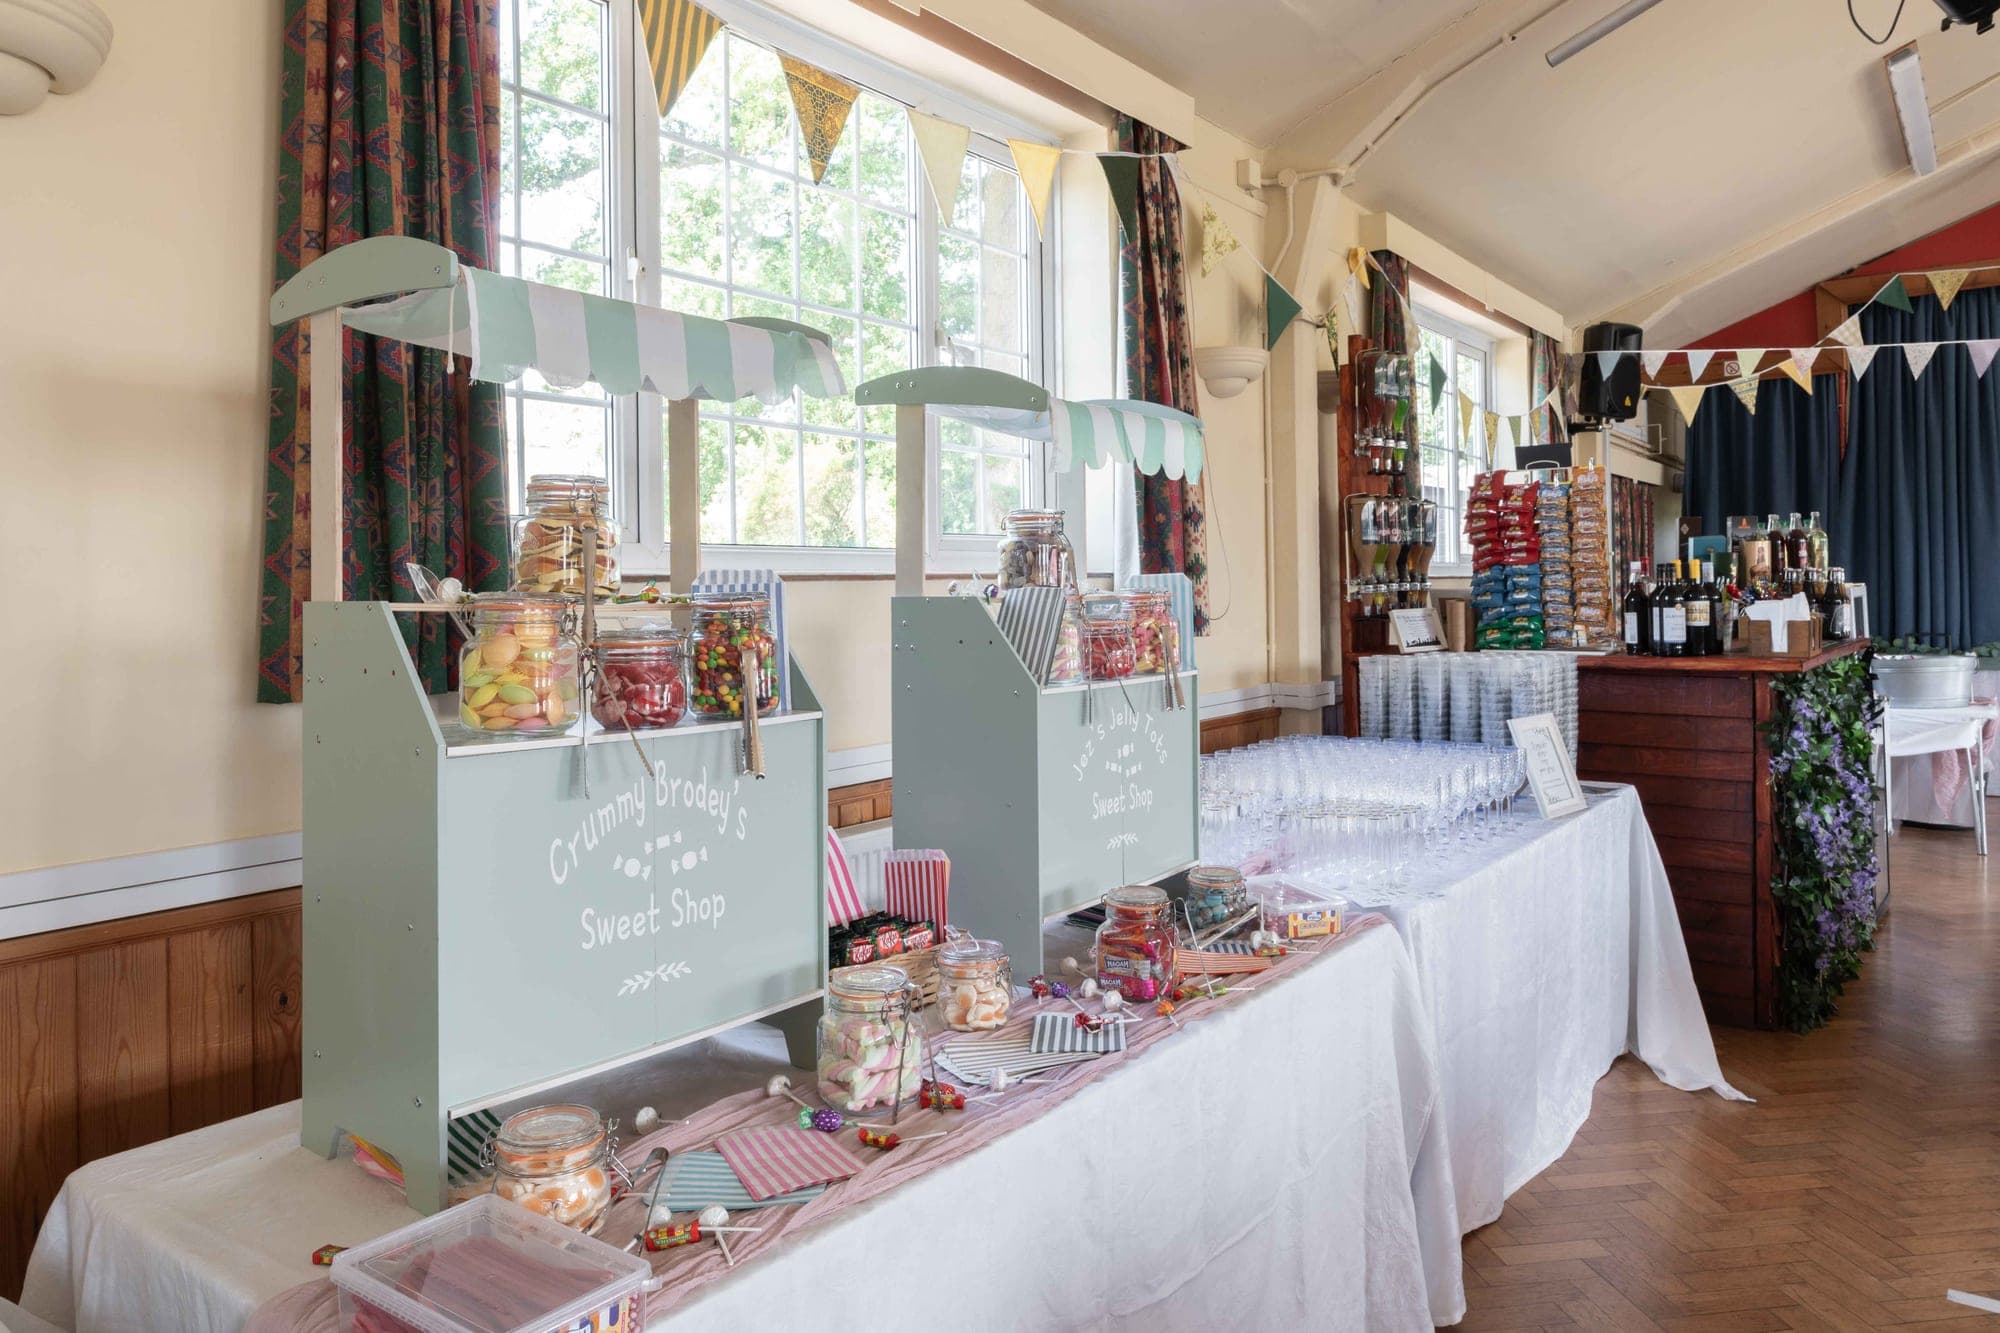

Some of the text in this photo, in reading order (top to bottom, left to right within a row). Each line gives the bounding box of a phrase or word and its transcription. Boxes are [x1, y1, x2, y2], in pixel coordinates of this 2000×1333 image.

[1109, 704, 1140, 732] Jelly
[1145, 714, 1168, 765] Tots
[549, 759, 750, 885] Crummy Brodey's
[1092, 783, 1153, 820] Sweet Shop
[580, 887, 726, 951] Sweet Shop
[1107, 959, 1129, 968] MAOAM
